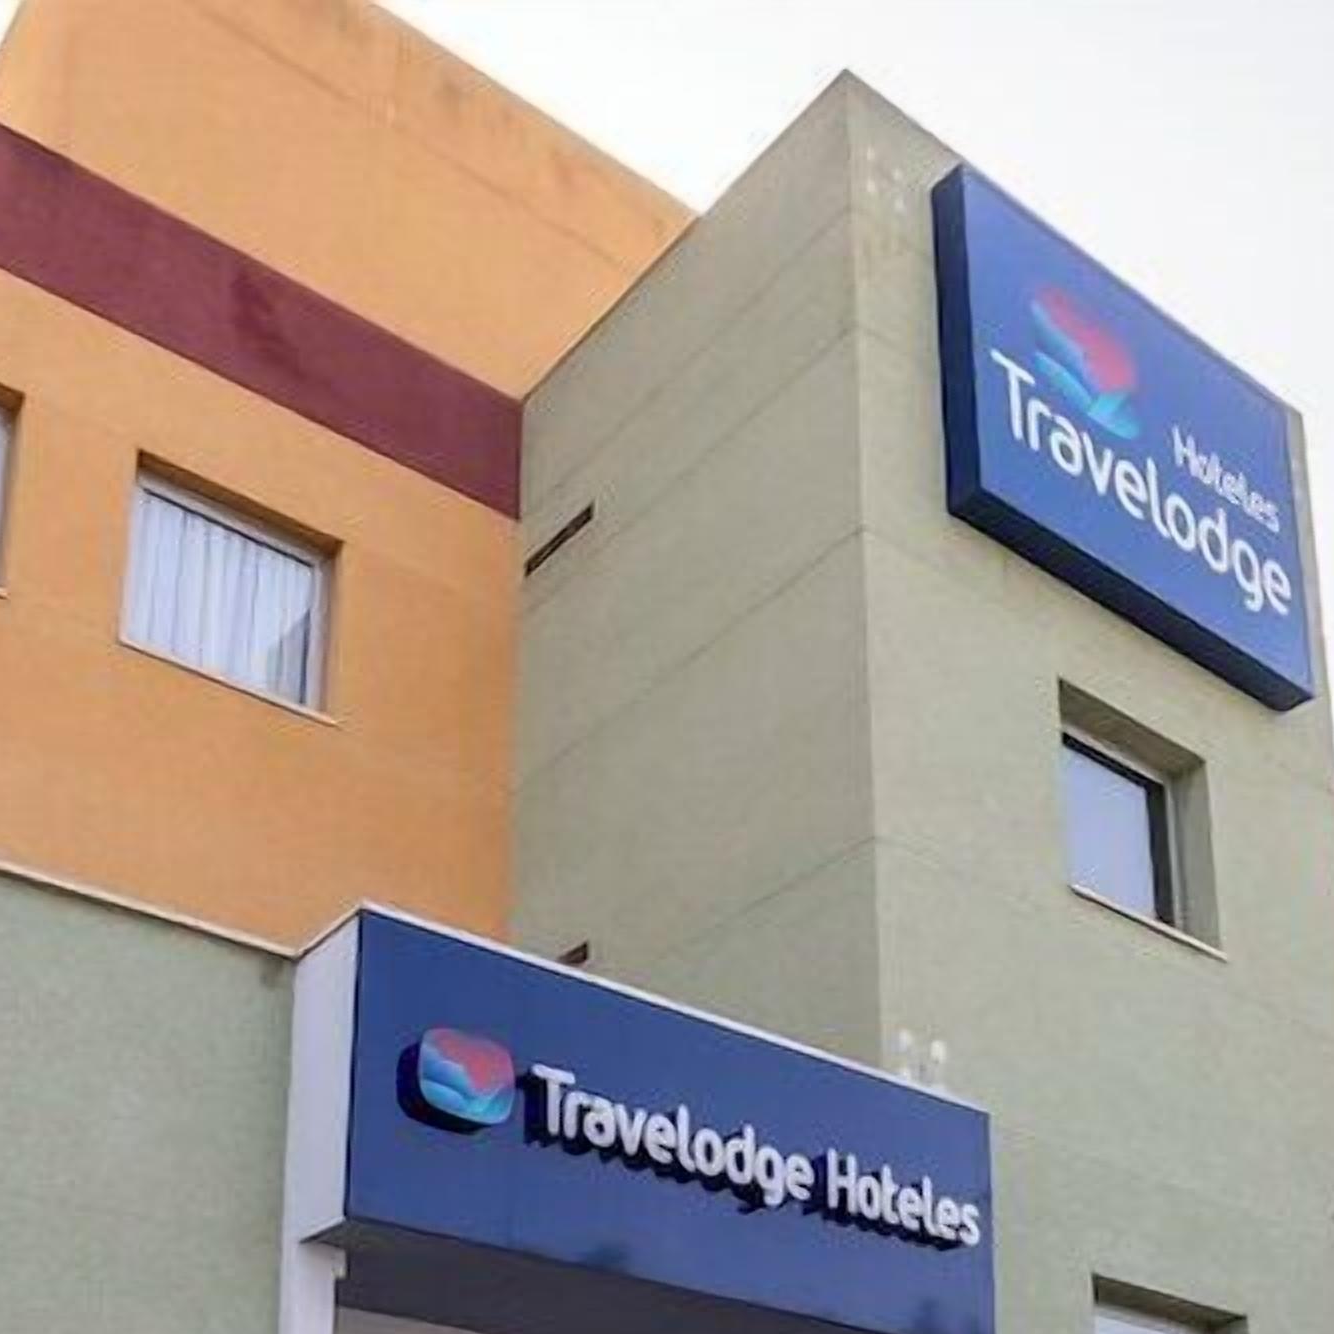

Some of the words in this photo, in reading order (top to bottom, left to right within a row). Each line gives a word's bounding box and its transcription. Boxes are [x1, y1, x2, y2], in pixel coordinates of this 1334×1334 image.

[990, 348, 1292, 616] Travelodge
[1172, 423, 1280, 533] Hoteles
[530, 1062, 815, 1207] Travelodge
[826, 1147, 982, 1247] Hoteles
